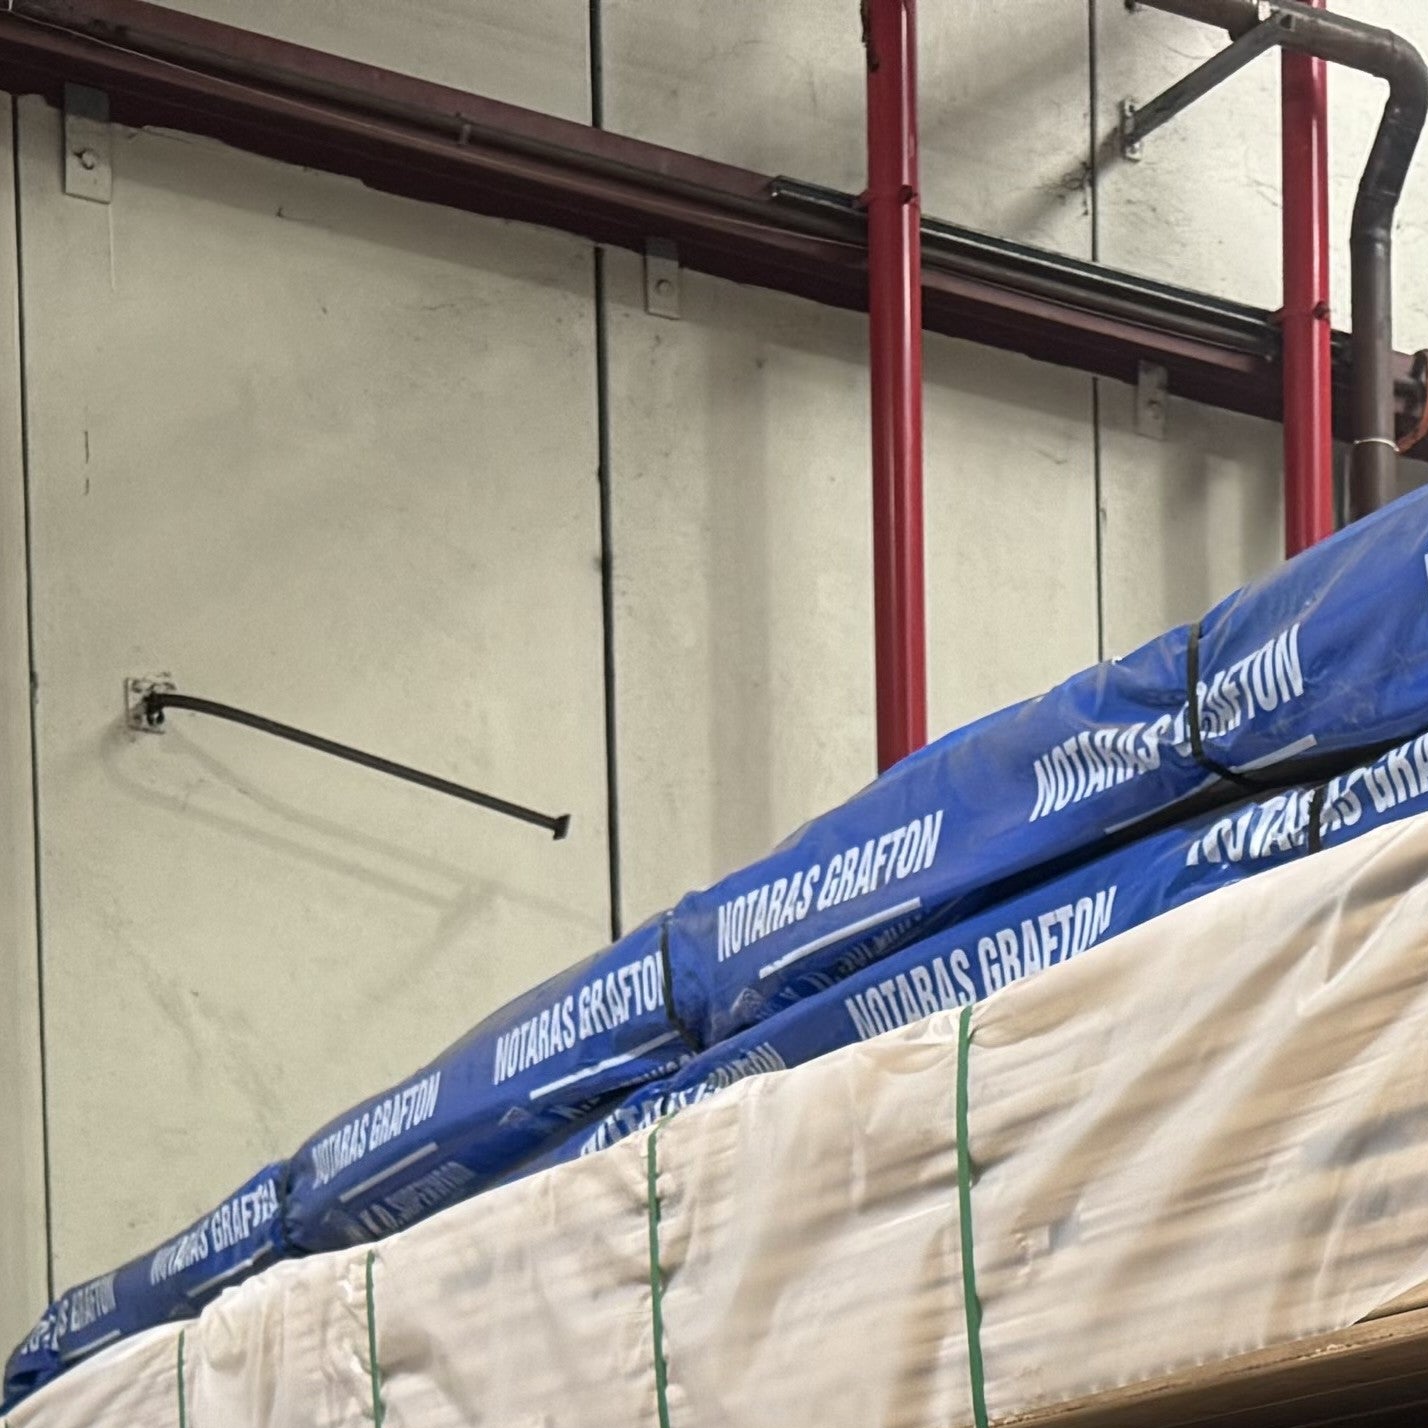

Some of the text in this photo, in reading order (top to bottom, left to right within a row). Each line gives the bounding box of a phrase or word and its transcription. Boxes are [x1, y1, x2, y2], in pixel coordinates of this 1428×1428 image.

[1029, 714, 1174, 822] NOTARAS
[717, 810, 944, 962] NOTARAS GRAFTON
[978, 887, 1116, 999] GRAFTON
[493, 1012, 576, 1085] NOTARAS
[371, 1071, 440, 1147] GRAFTON
